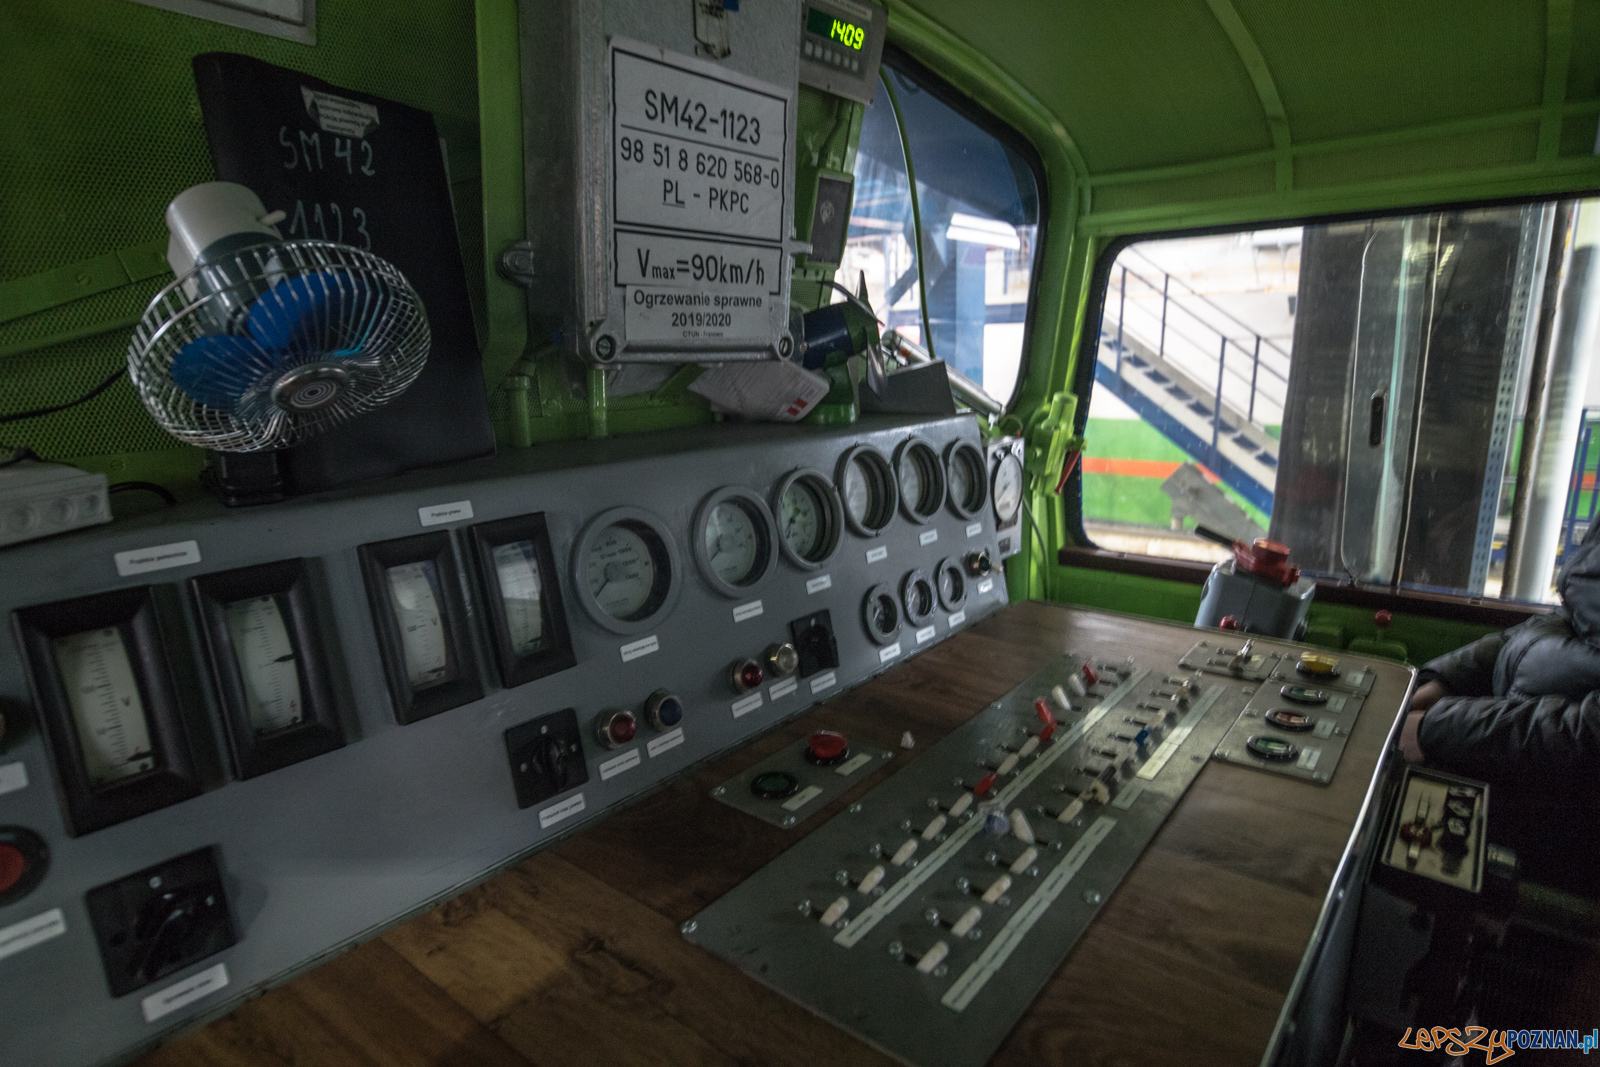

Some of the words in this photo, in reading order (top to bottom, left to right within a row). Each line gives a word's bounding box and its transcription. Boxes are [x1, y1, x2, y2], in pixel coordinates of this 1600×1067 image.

[830, 19, 865, 50] 1409
[645, 89, 760, 144] SM42-1123
[279, 125, 323, 172] SM
[334, 138, 376, 176] 42
[621, 137, 644, 163] 98
[653, 143, 670, 169] 51
[678, 148, 688, 171] 8
[696, 153, 727, 179] 620
[734, 160, 780, 189] 568-0
[663, 180, 685, 204] PL
[709, 187, 749, 214] PKPC
[289, 199, 372, 254] 1123
[634, 289, 710, 309] Ogrzewanie
[714, 295, 762, 309] sprawne
[671, 312, 731, 327] 2019/2020
